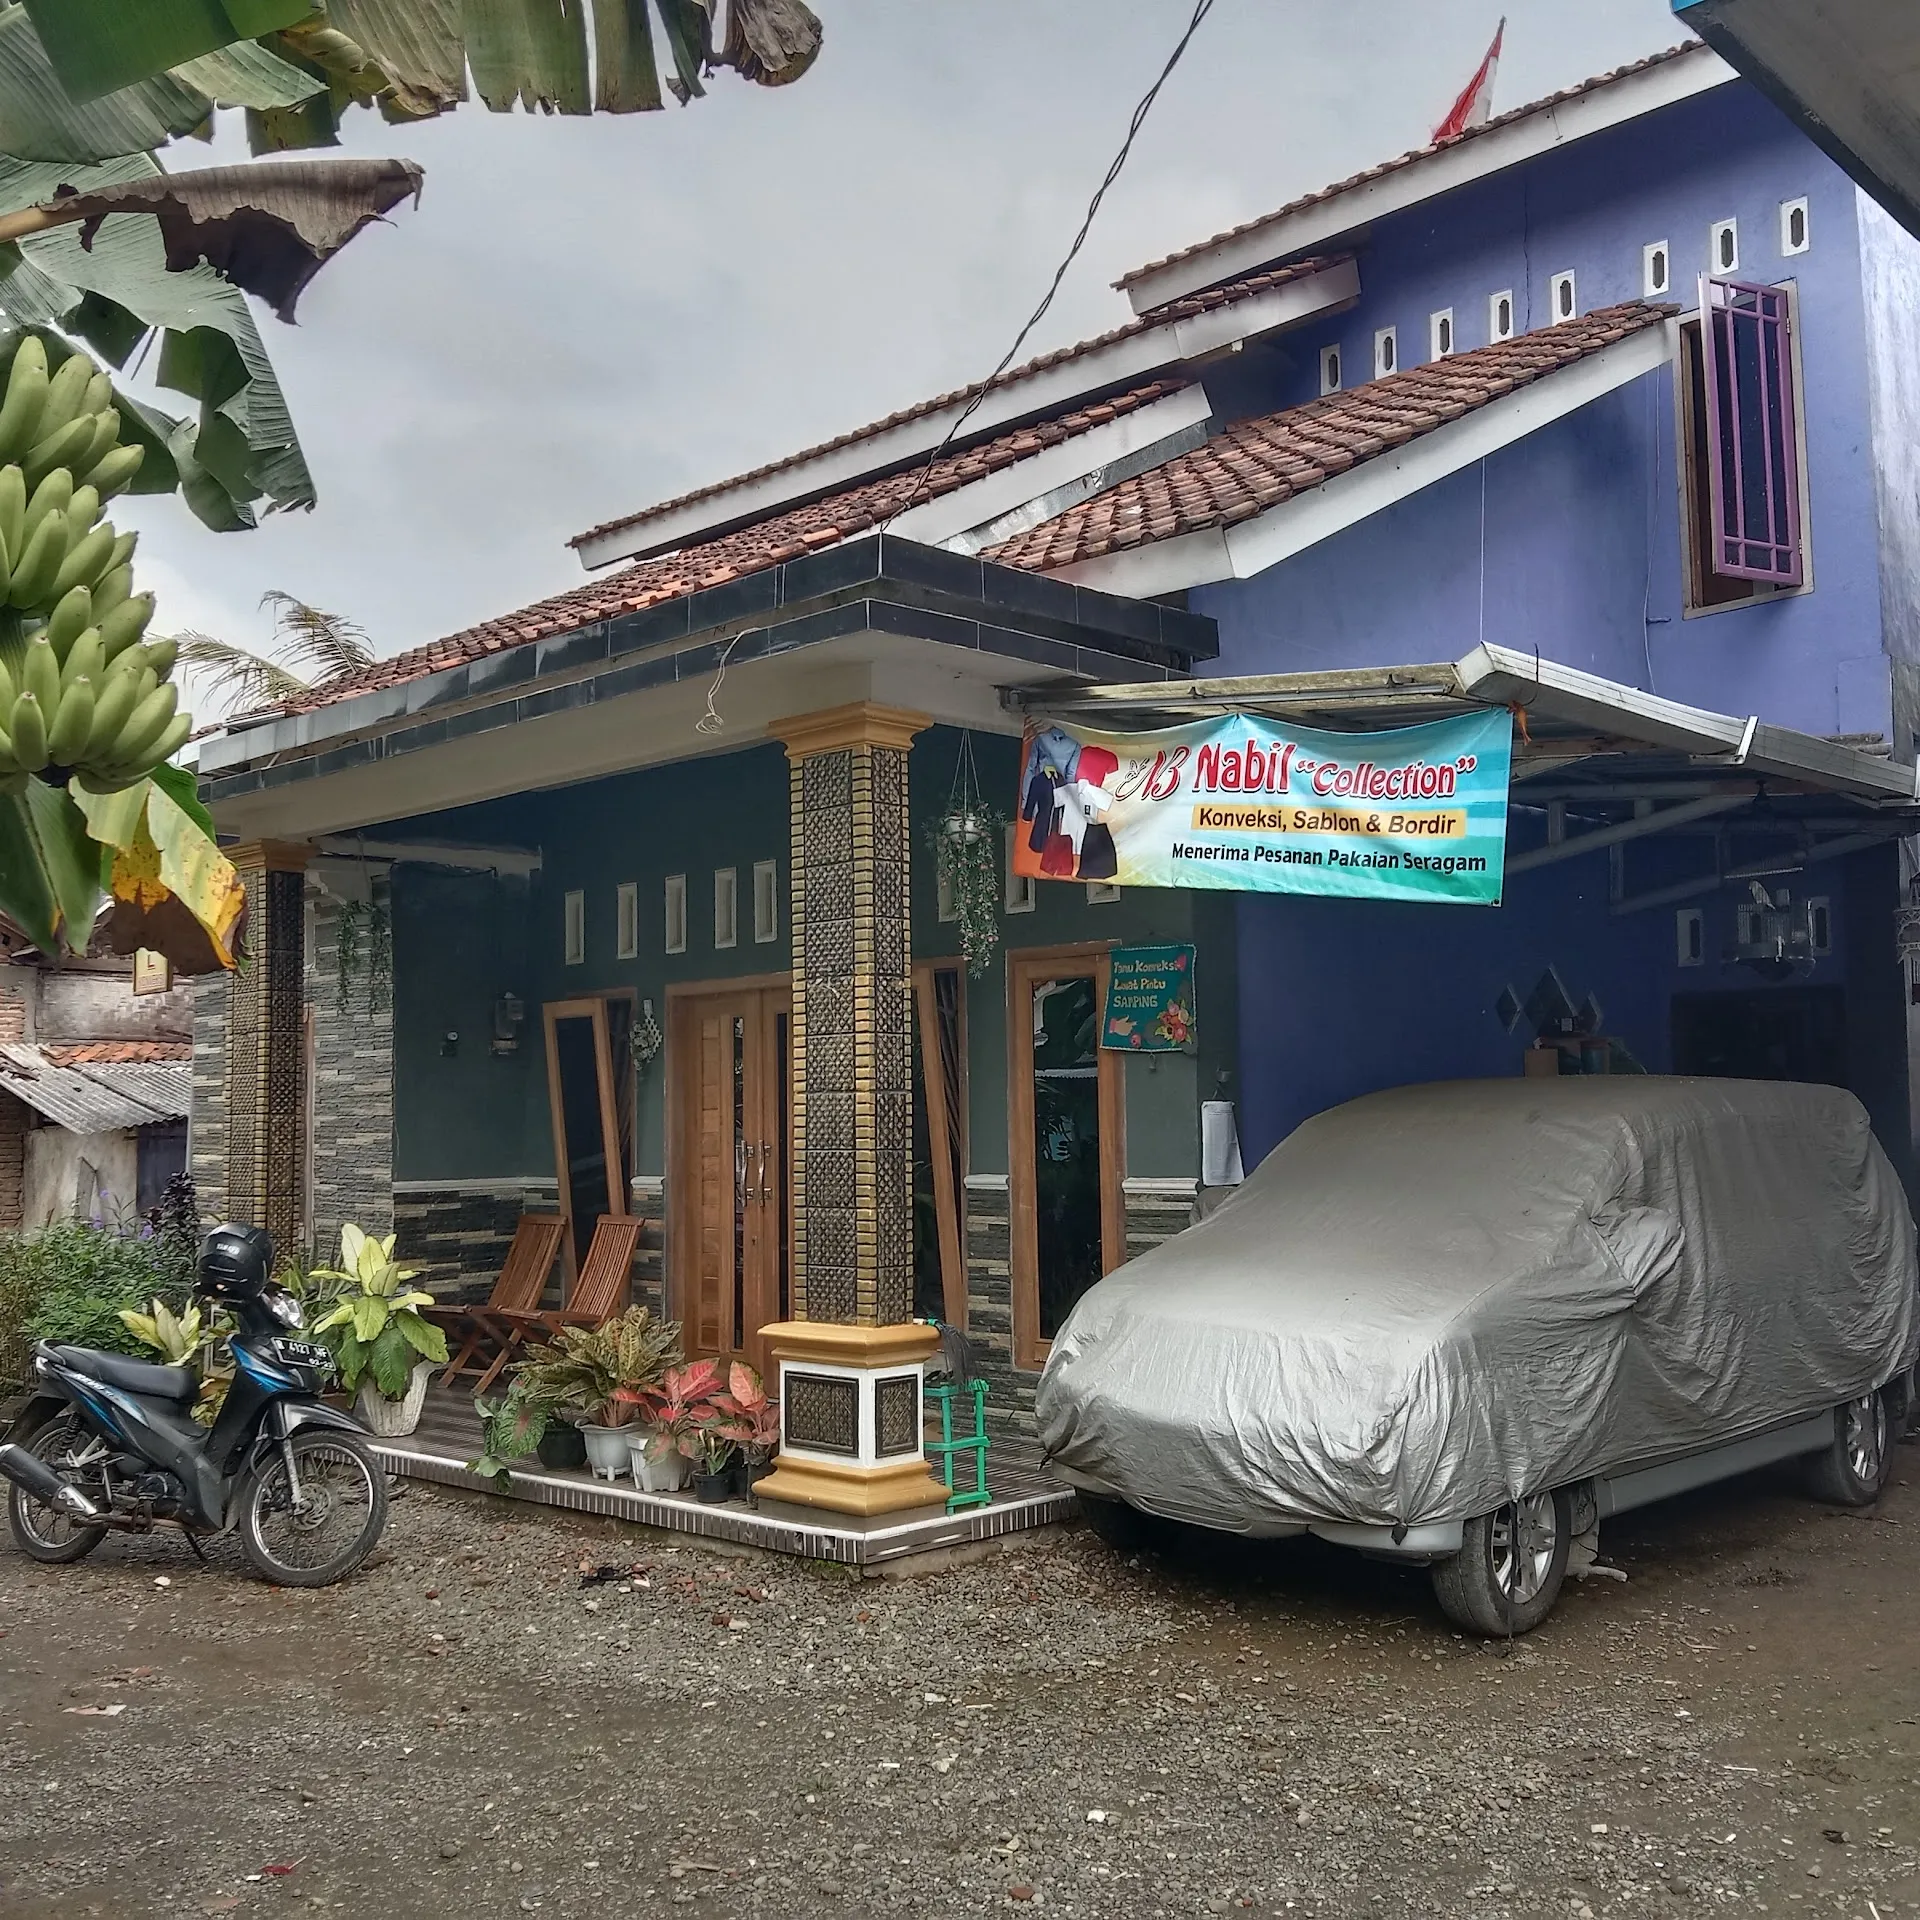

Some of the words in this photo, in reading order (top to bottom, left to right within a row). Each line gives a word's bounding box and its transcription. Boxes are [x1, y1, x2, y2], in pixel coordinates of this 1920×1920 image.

[1192, 739, 1297, 794] Nabil
[1199, 808, 1287, 832] Konveksi,
[1293, 811, 1360, 832] Sablon
[1365, 814, 1381, 833] &
[1388, 815, 1456, 834] Bordir
[1172, 843, 1249, 861] Menerima
[1254, 846, 1322, 865] Pesanan
[1327, 849, 1399, 869] Pakaian
[1403, 852, 1486, 875] Seragam
[1140, 977, 1166, 990] Pintu
[1112, 995, 1159, 1009] SAMPING
